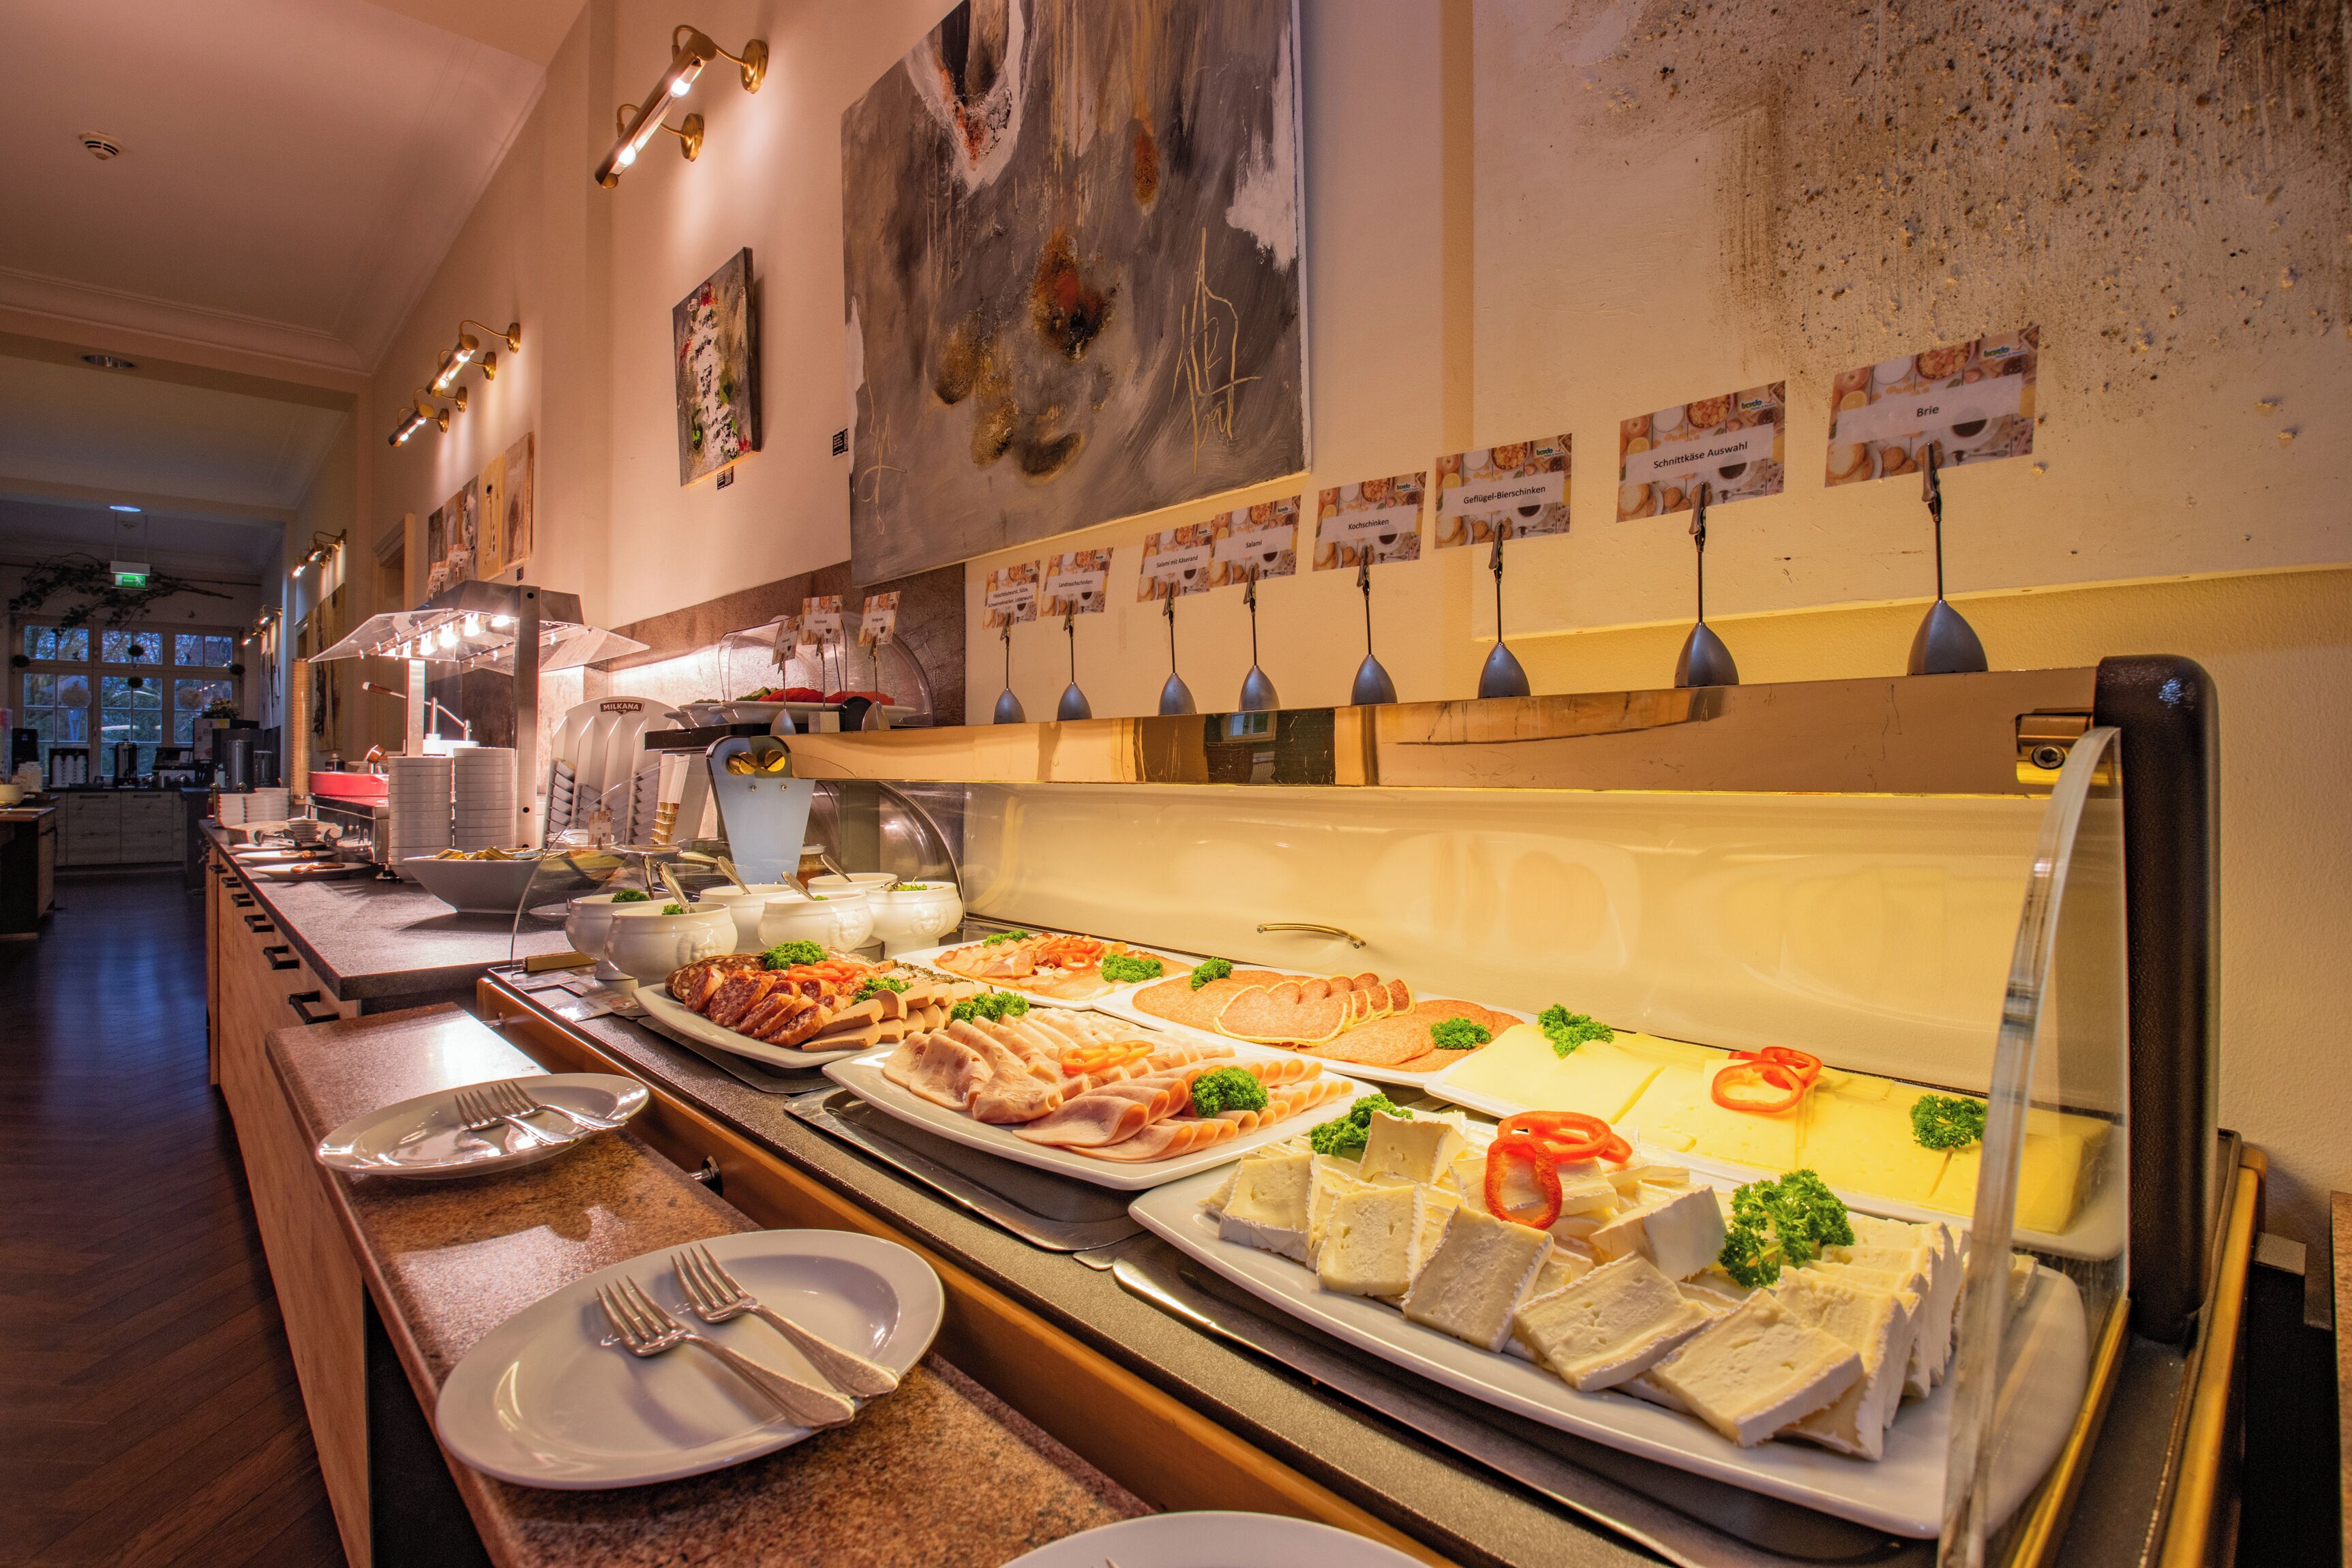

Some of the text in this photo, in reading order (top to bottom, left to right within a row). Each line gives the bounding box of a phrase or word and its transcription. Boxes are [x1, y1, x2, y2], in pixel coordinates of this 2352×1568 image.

[1916, 406, 1940, 417] Brie
[1653, 441, 1748, 469] Schnittkäse Auswahl
[1463, 486, 1546, 504] Geflügel-Bierschinken
[1348, 519, 1389, 530] Kochschinken
[1246, 539, 1263, 548] Salami
[1178, 555, 1198, 564] Käserand
[1058, 579, 1094, 588] Landrauchschinken
